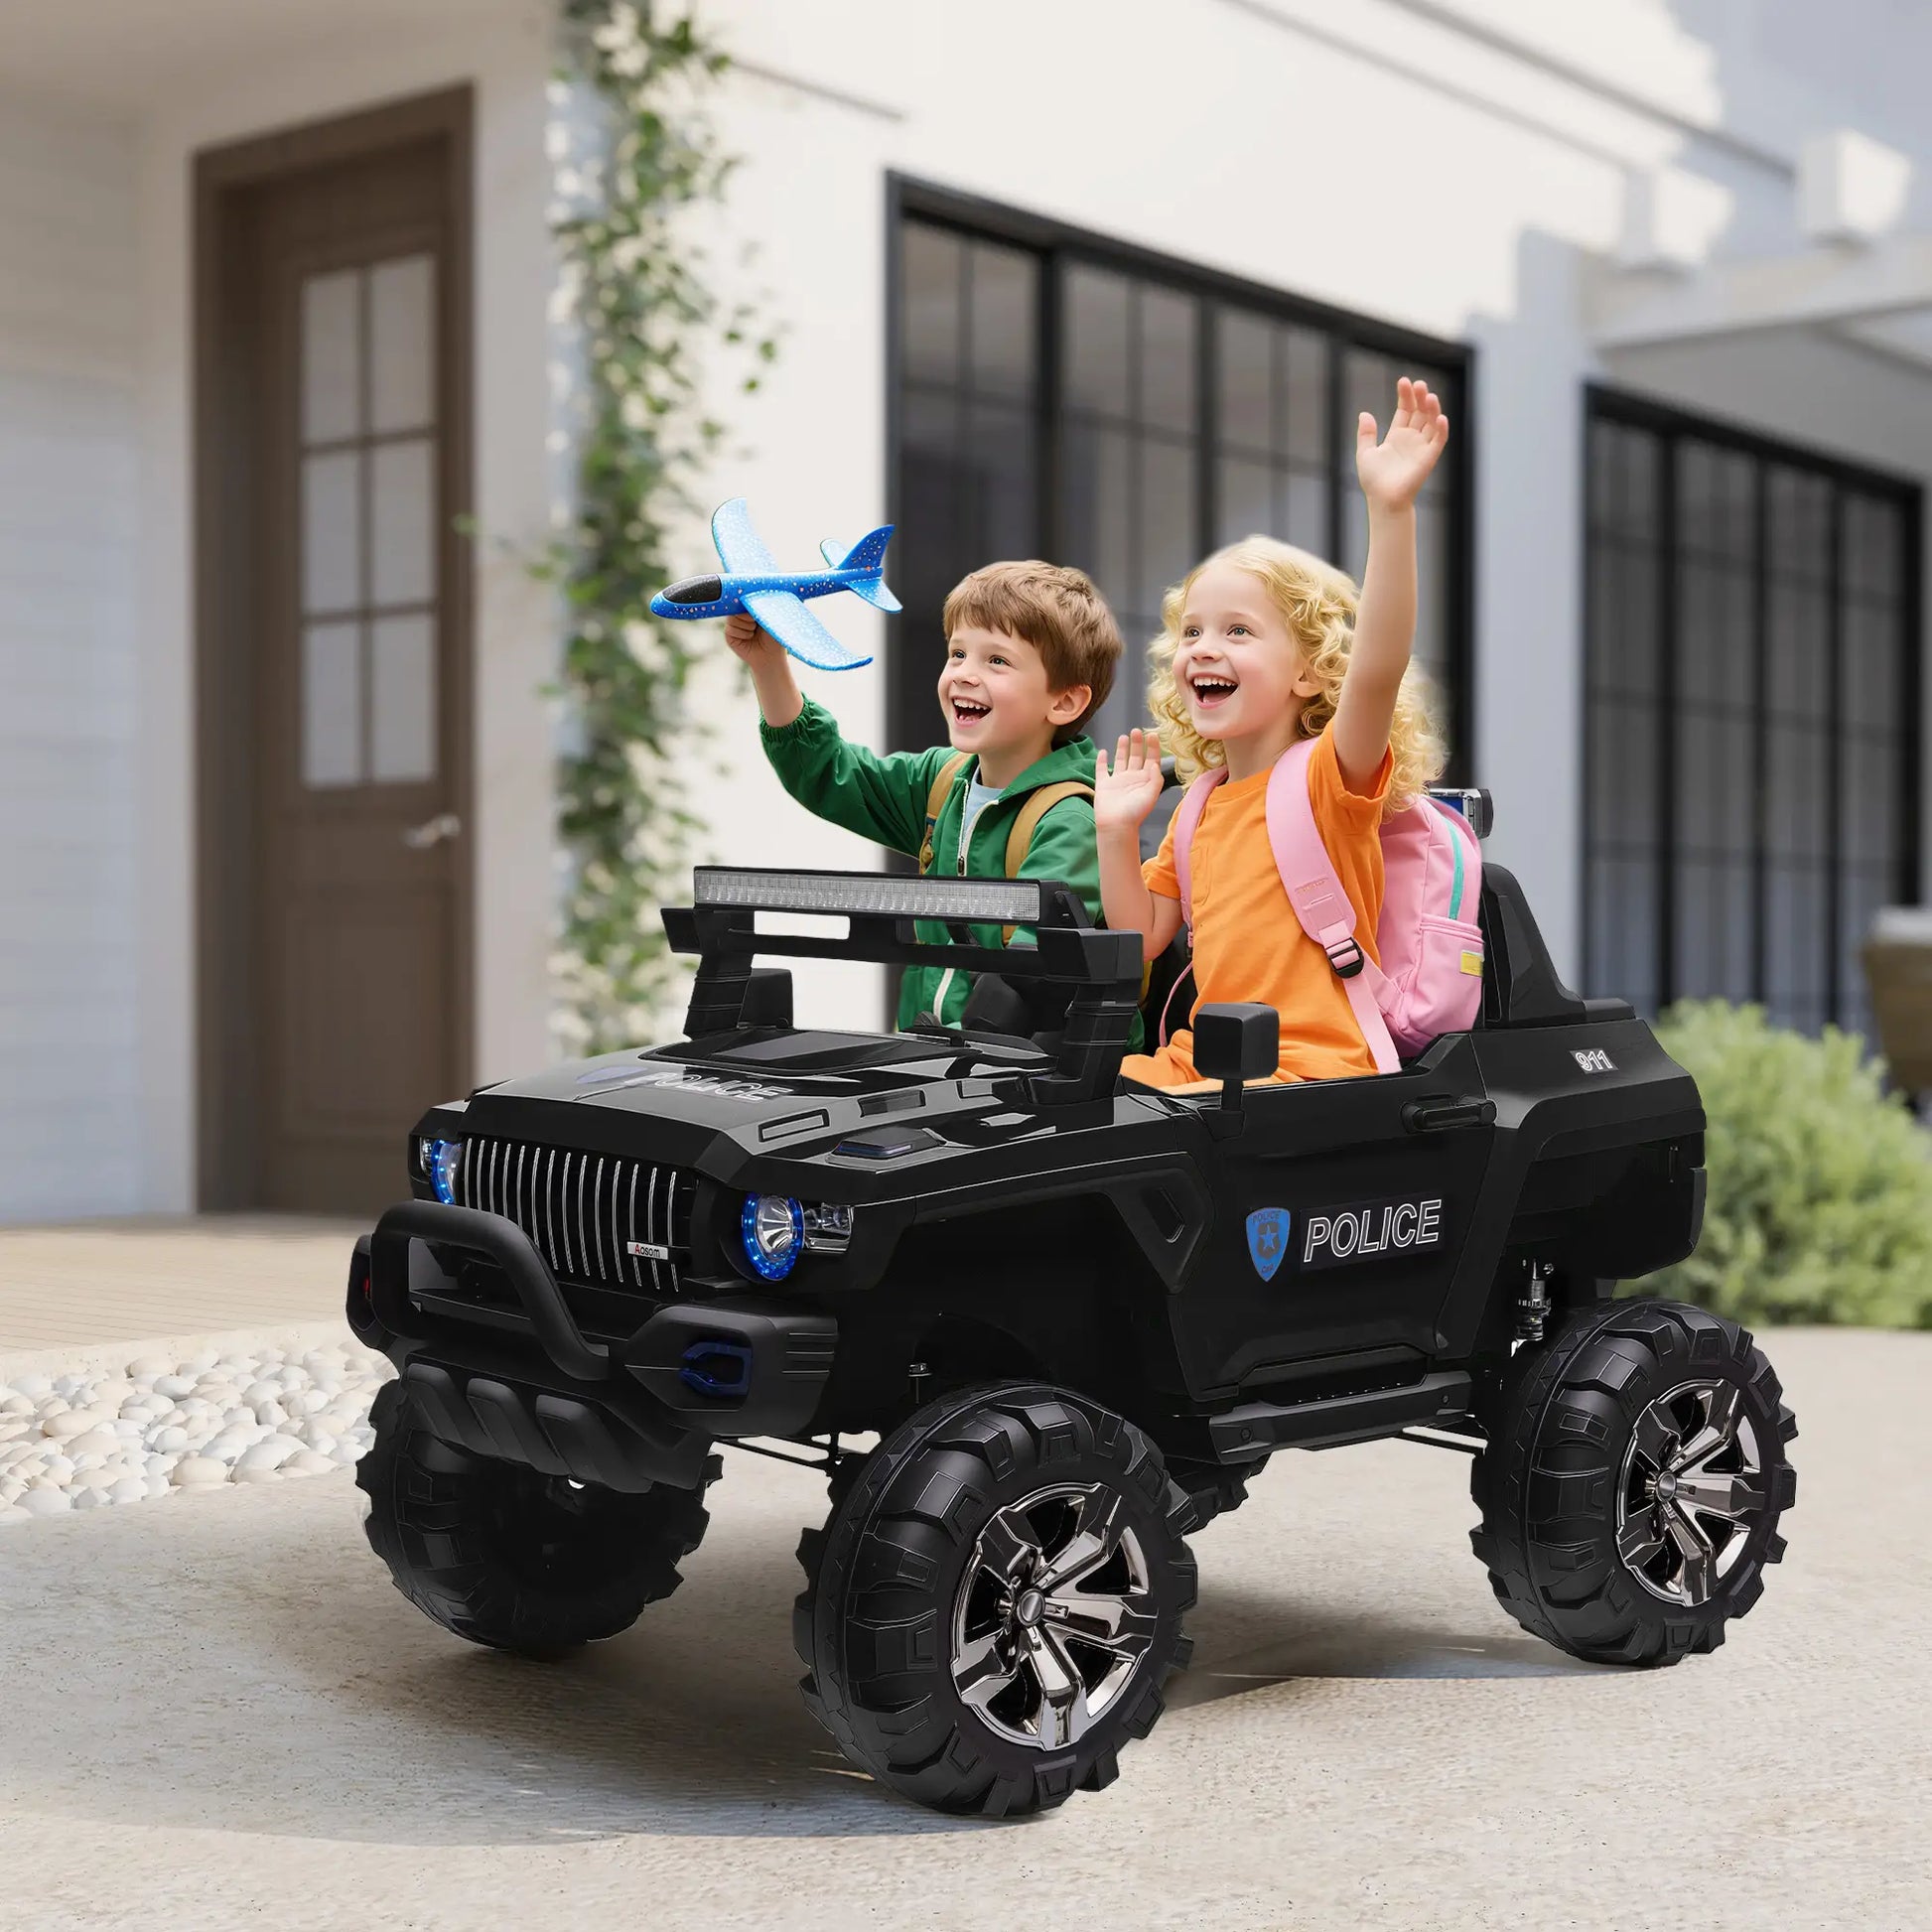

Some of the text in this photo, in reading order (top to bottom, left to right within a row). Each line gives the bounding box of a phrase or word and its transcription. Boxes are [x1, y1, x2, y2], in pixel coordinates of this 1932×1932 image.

[1575, 1049, 1613, 1071] 911
[623, 1071, 795, 1103] POLICE
[1303, 1198, 1443, 1263] POLICE
[634, 1243, 661, 1258] Aosom
